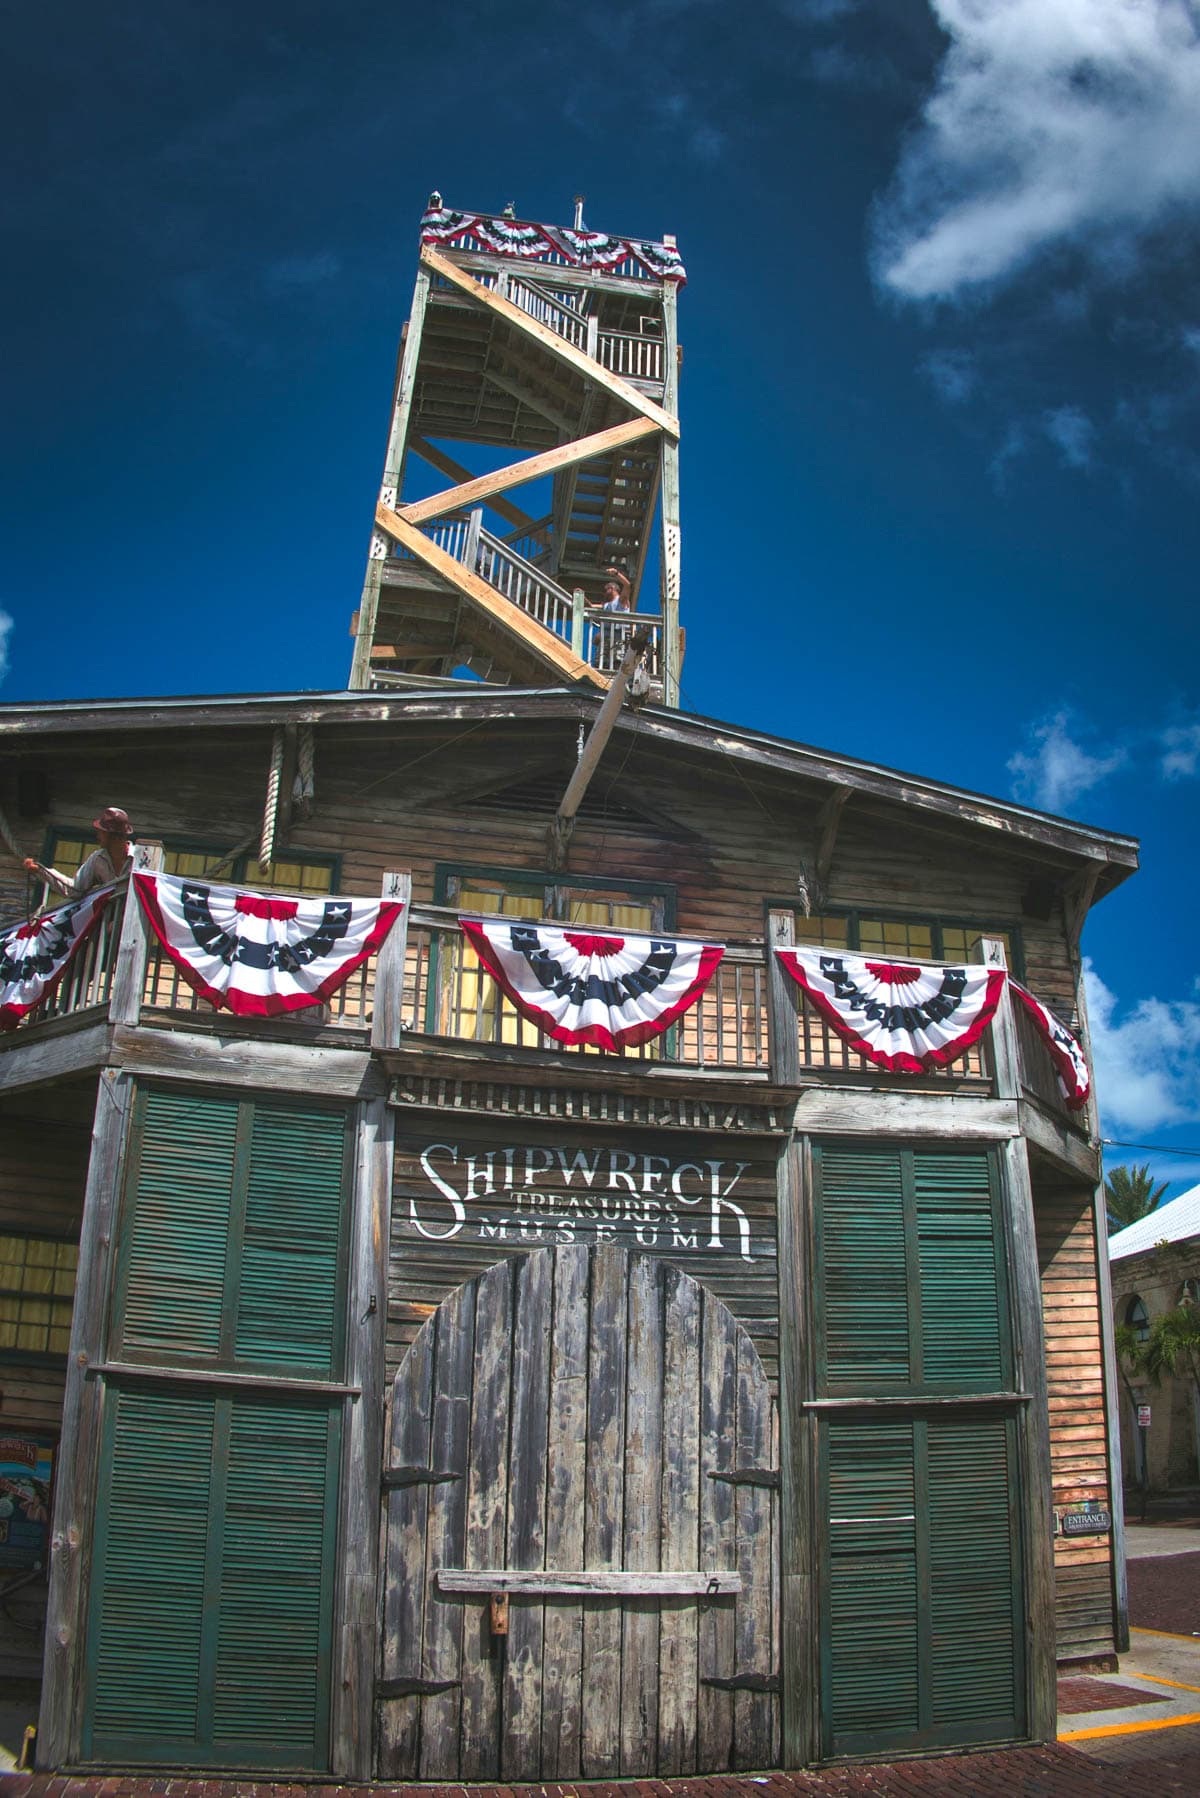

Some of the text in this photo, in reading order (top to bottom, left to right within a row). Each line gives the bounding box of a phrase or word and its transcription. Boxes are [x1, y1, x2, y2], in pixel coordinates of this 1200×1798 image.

[409, 1143, 757, 1263] SHIPWRECK
[510, 1191, 680, 1224] TREASURES
[477, 1216, 699, 1249] MUSEUM
[1068, 1513, 1106, 1525] ENTRANCE
